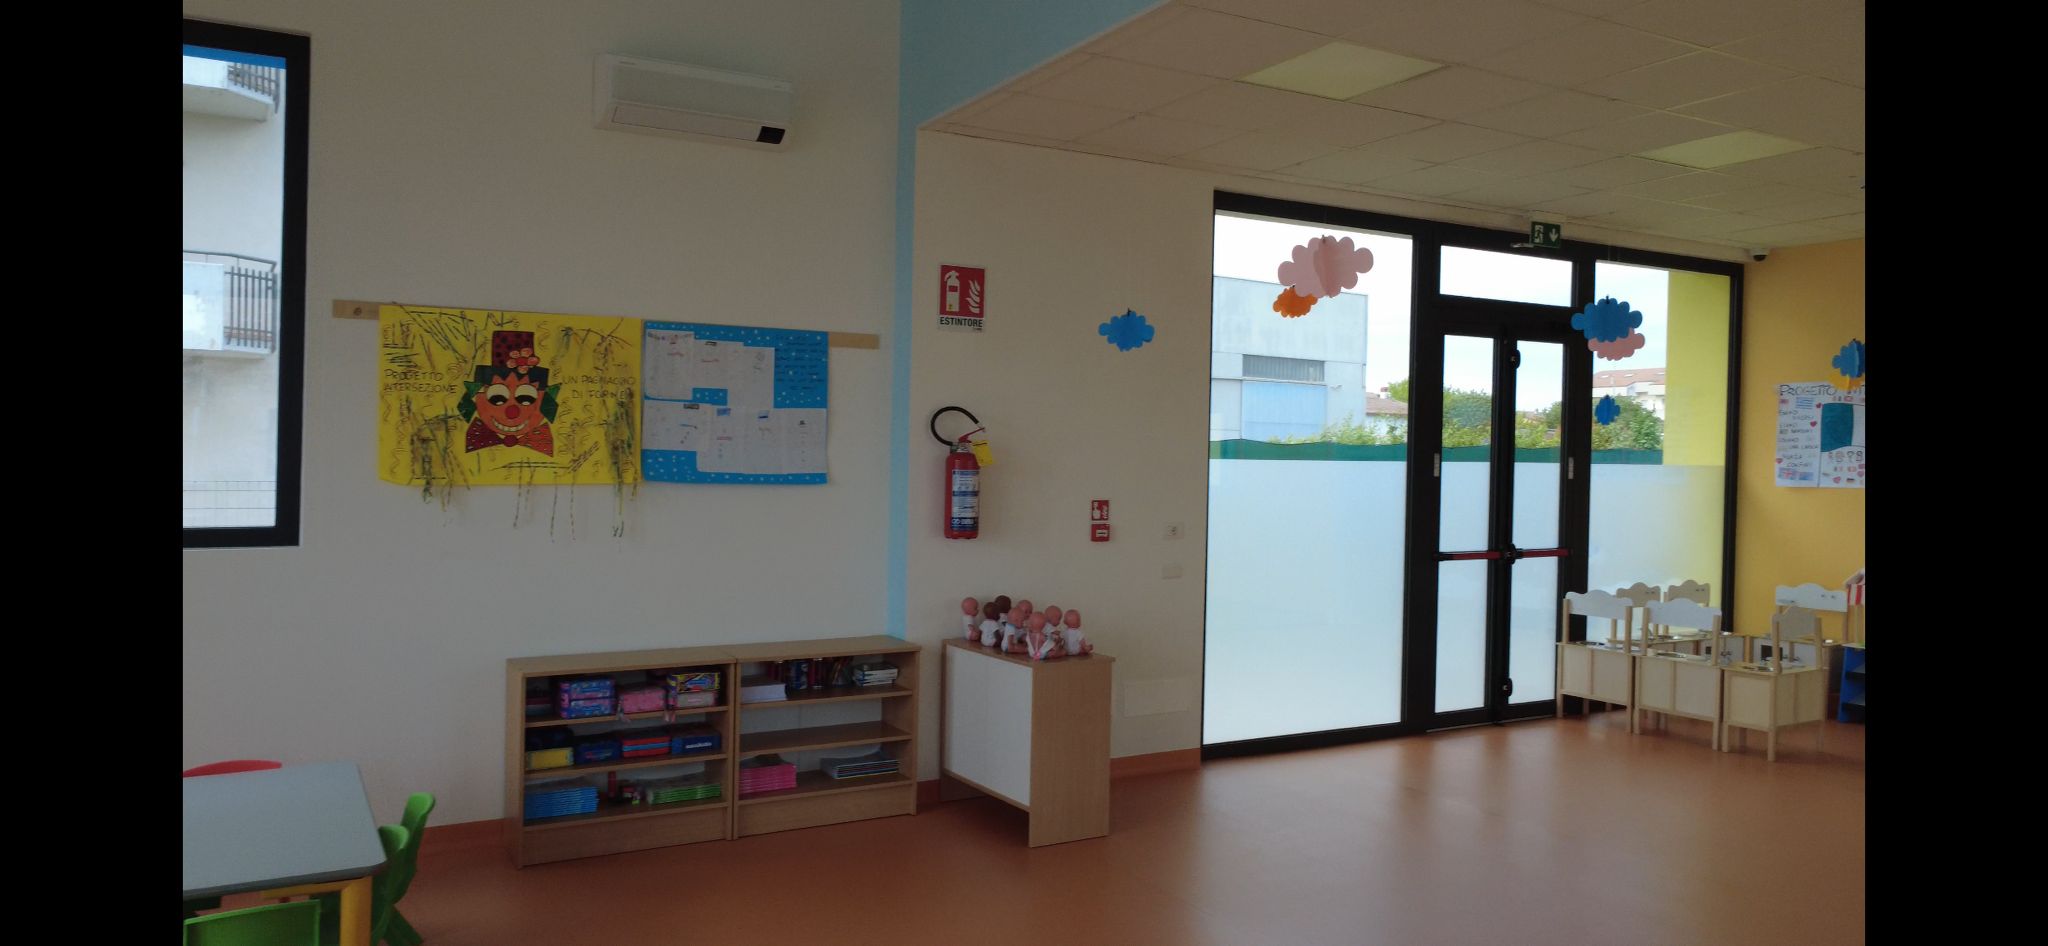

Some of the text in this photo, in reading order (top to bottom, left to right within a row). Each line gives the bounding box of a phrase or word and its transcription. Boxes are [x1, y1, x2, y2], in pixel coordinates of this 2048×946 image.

[939, 316, 983, 328] ESTINTORE
[384, 368, 443, 382] PROGETTO
[562, 375, 579, 385] UN
[571, 389, 583, 399] DI
[1779, 384, 1837, 397] PROGETTO
